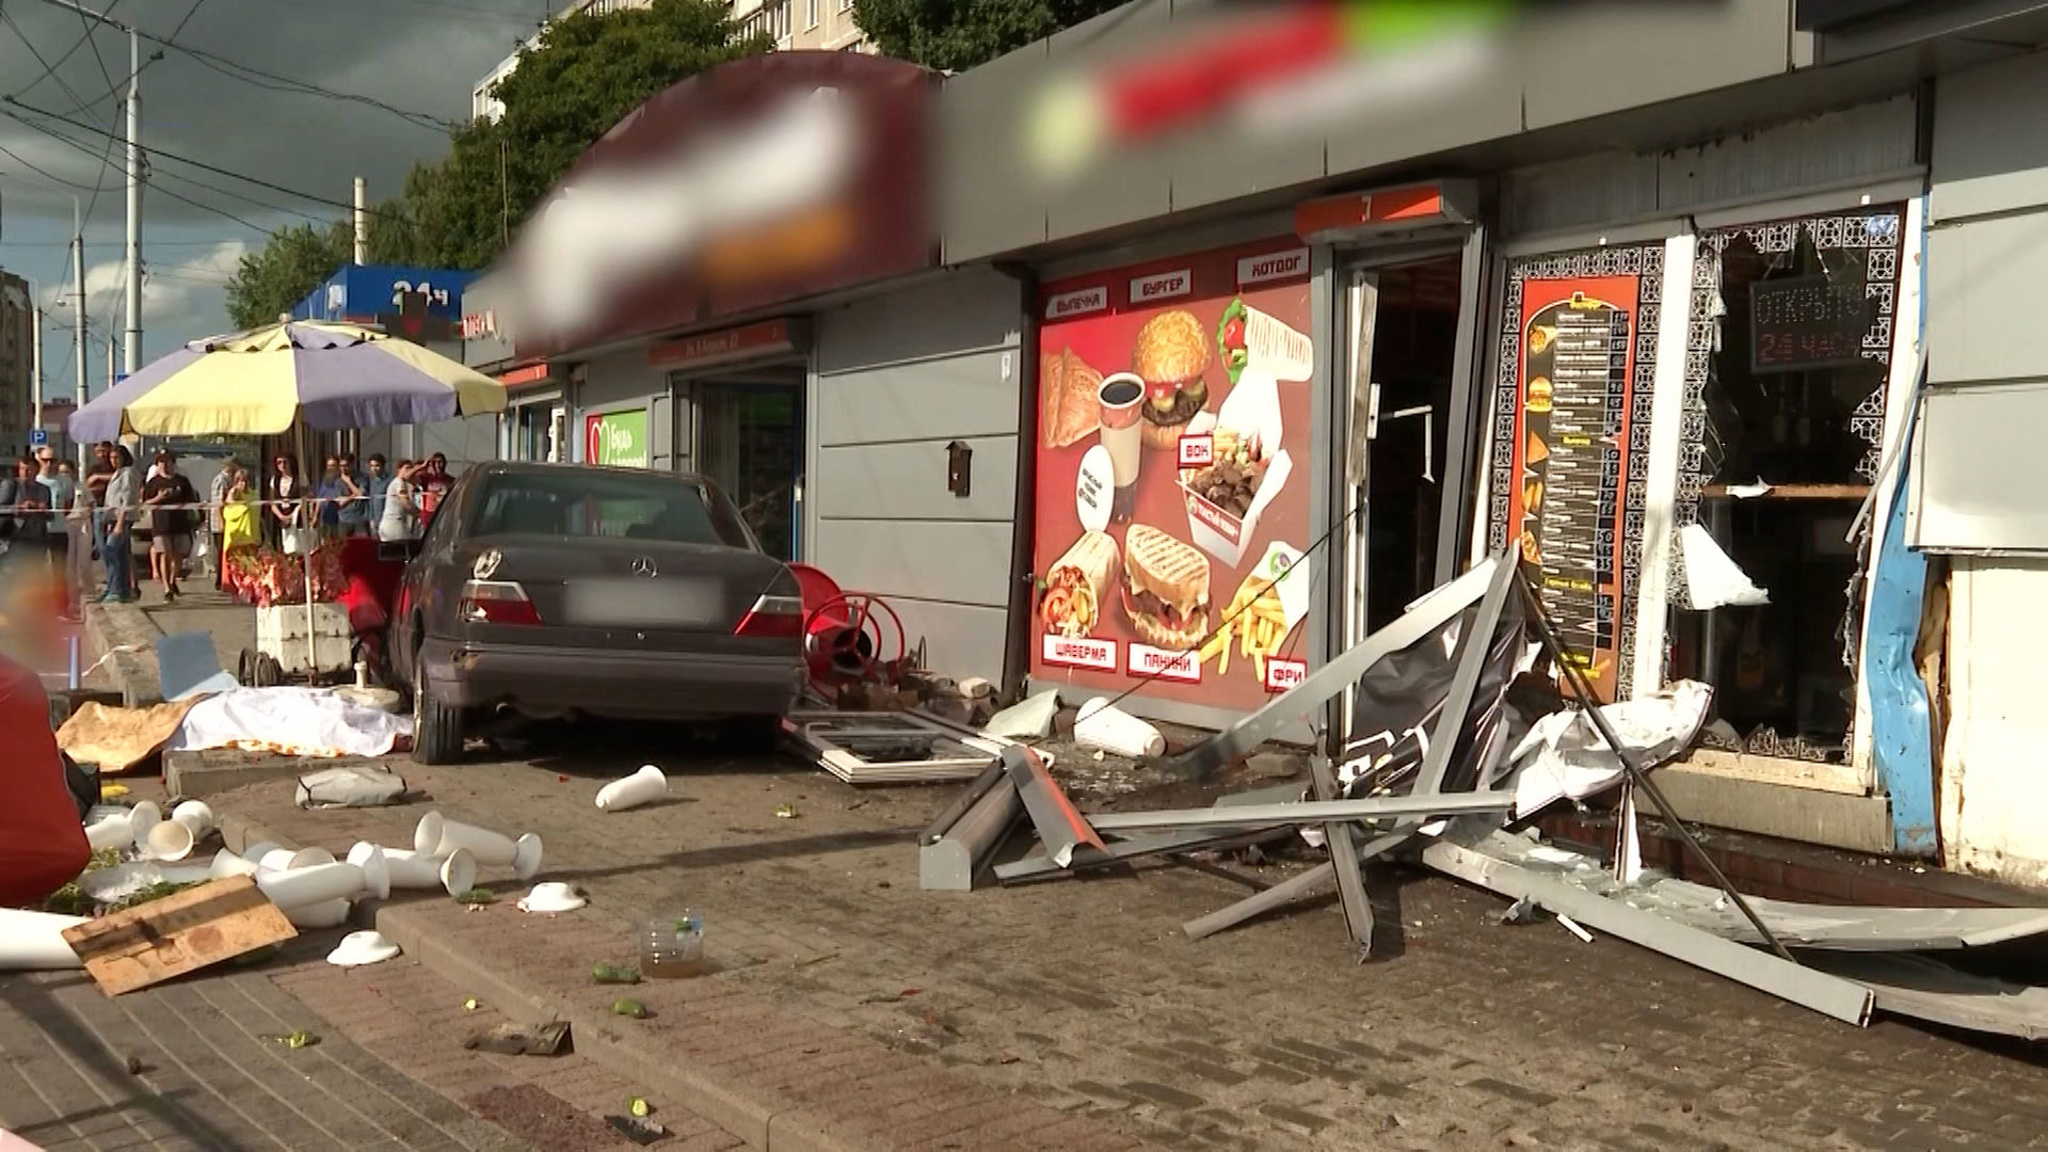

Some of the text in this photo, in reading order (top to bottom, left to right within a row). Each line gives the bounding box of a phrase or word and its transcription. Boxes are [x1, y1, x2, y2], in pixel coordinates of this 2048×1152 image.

[1251, 255, 1302, 278] ХОТДОГ
[1141, 276, 1185, 298] БУРГЕР
[1055, 292, 1102, 314] ВЫПЕЧКА
[1185, 444, 1209, 459] ВОК
[1054, 643, 1107, 664] ШАВЕРМА
[1143, 652, 1192, 672] ПАНИНИ
[1273, 667, 1305, 683] ФРИ
